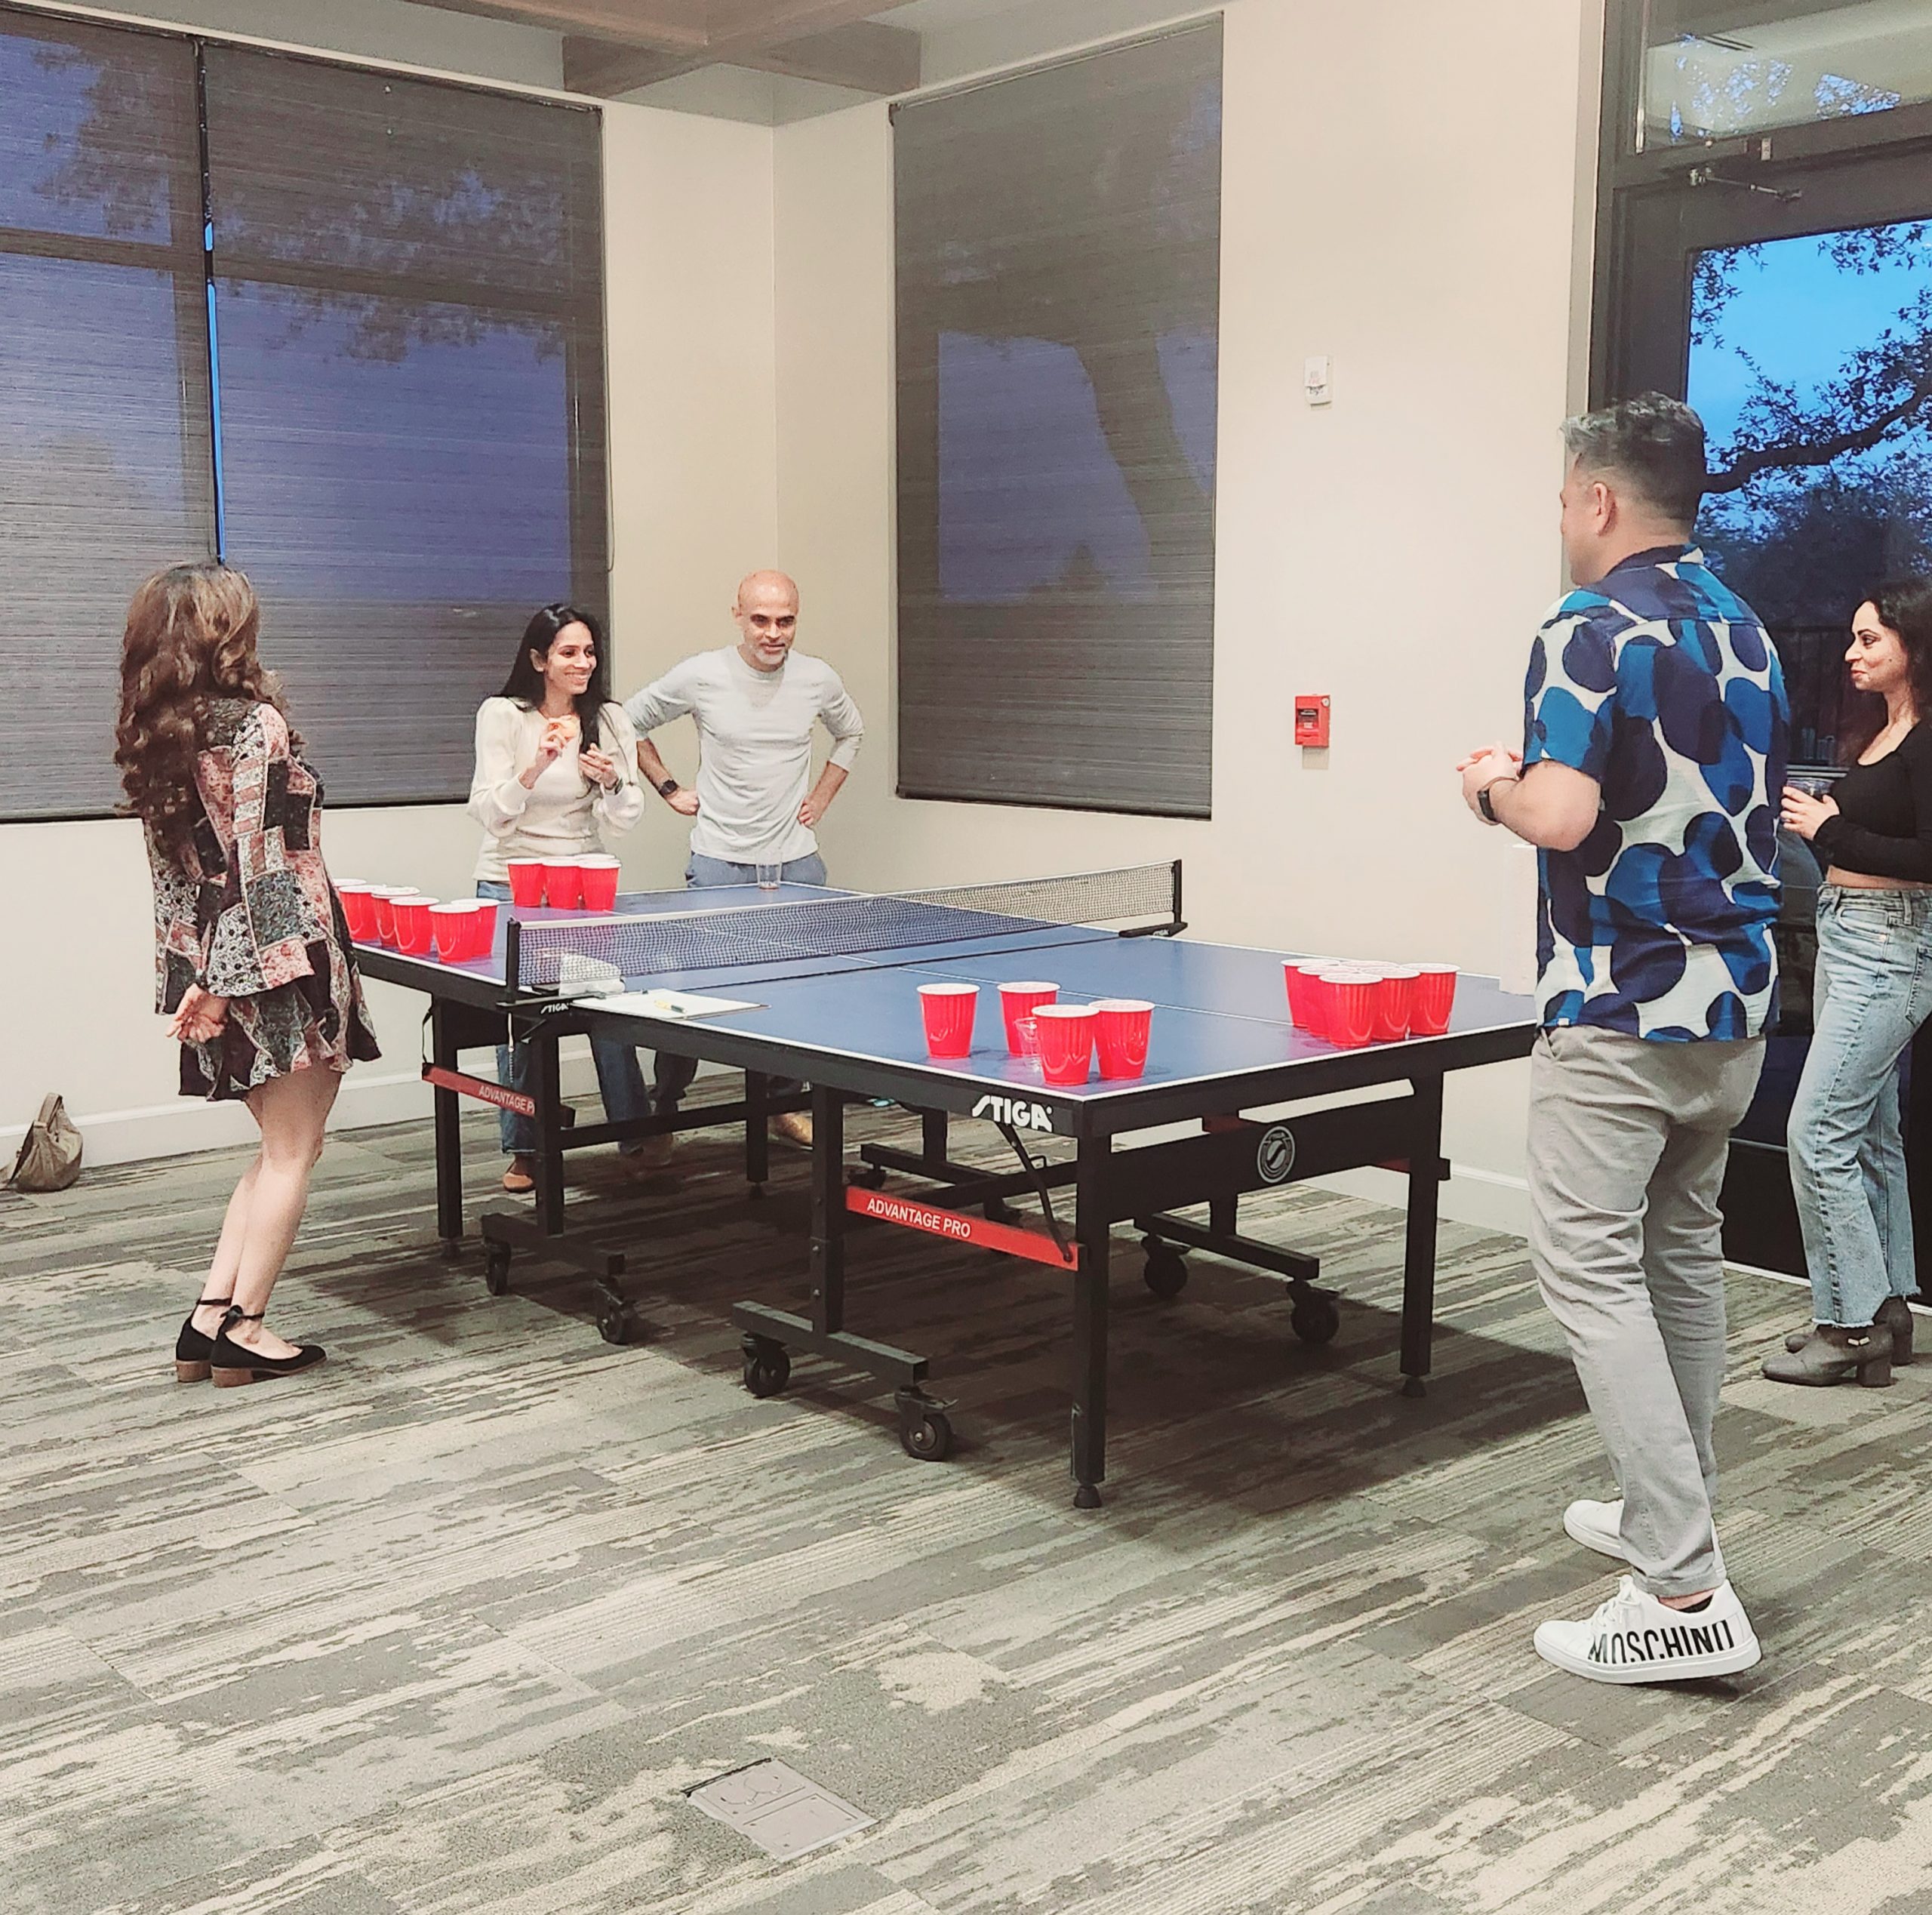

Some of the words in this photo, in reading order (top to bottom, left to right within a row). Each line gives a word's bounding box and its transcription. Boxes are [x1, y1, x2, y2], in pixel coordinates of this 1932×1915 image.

[540, 1002, 569, 1014] STIGA
[478, 1085, 526, 1111] ADVANTAGE
[972, 1095, 1052, 1132] STIGA
[867, 1198, 941, 1230] ADVANTAGE
[943, 1218, 971, 1238] PRO
[1588, 1620, 1734, 1664] MOSCHINO
